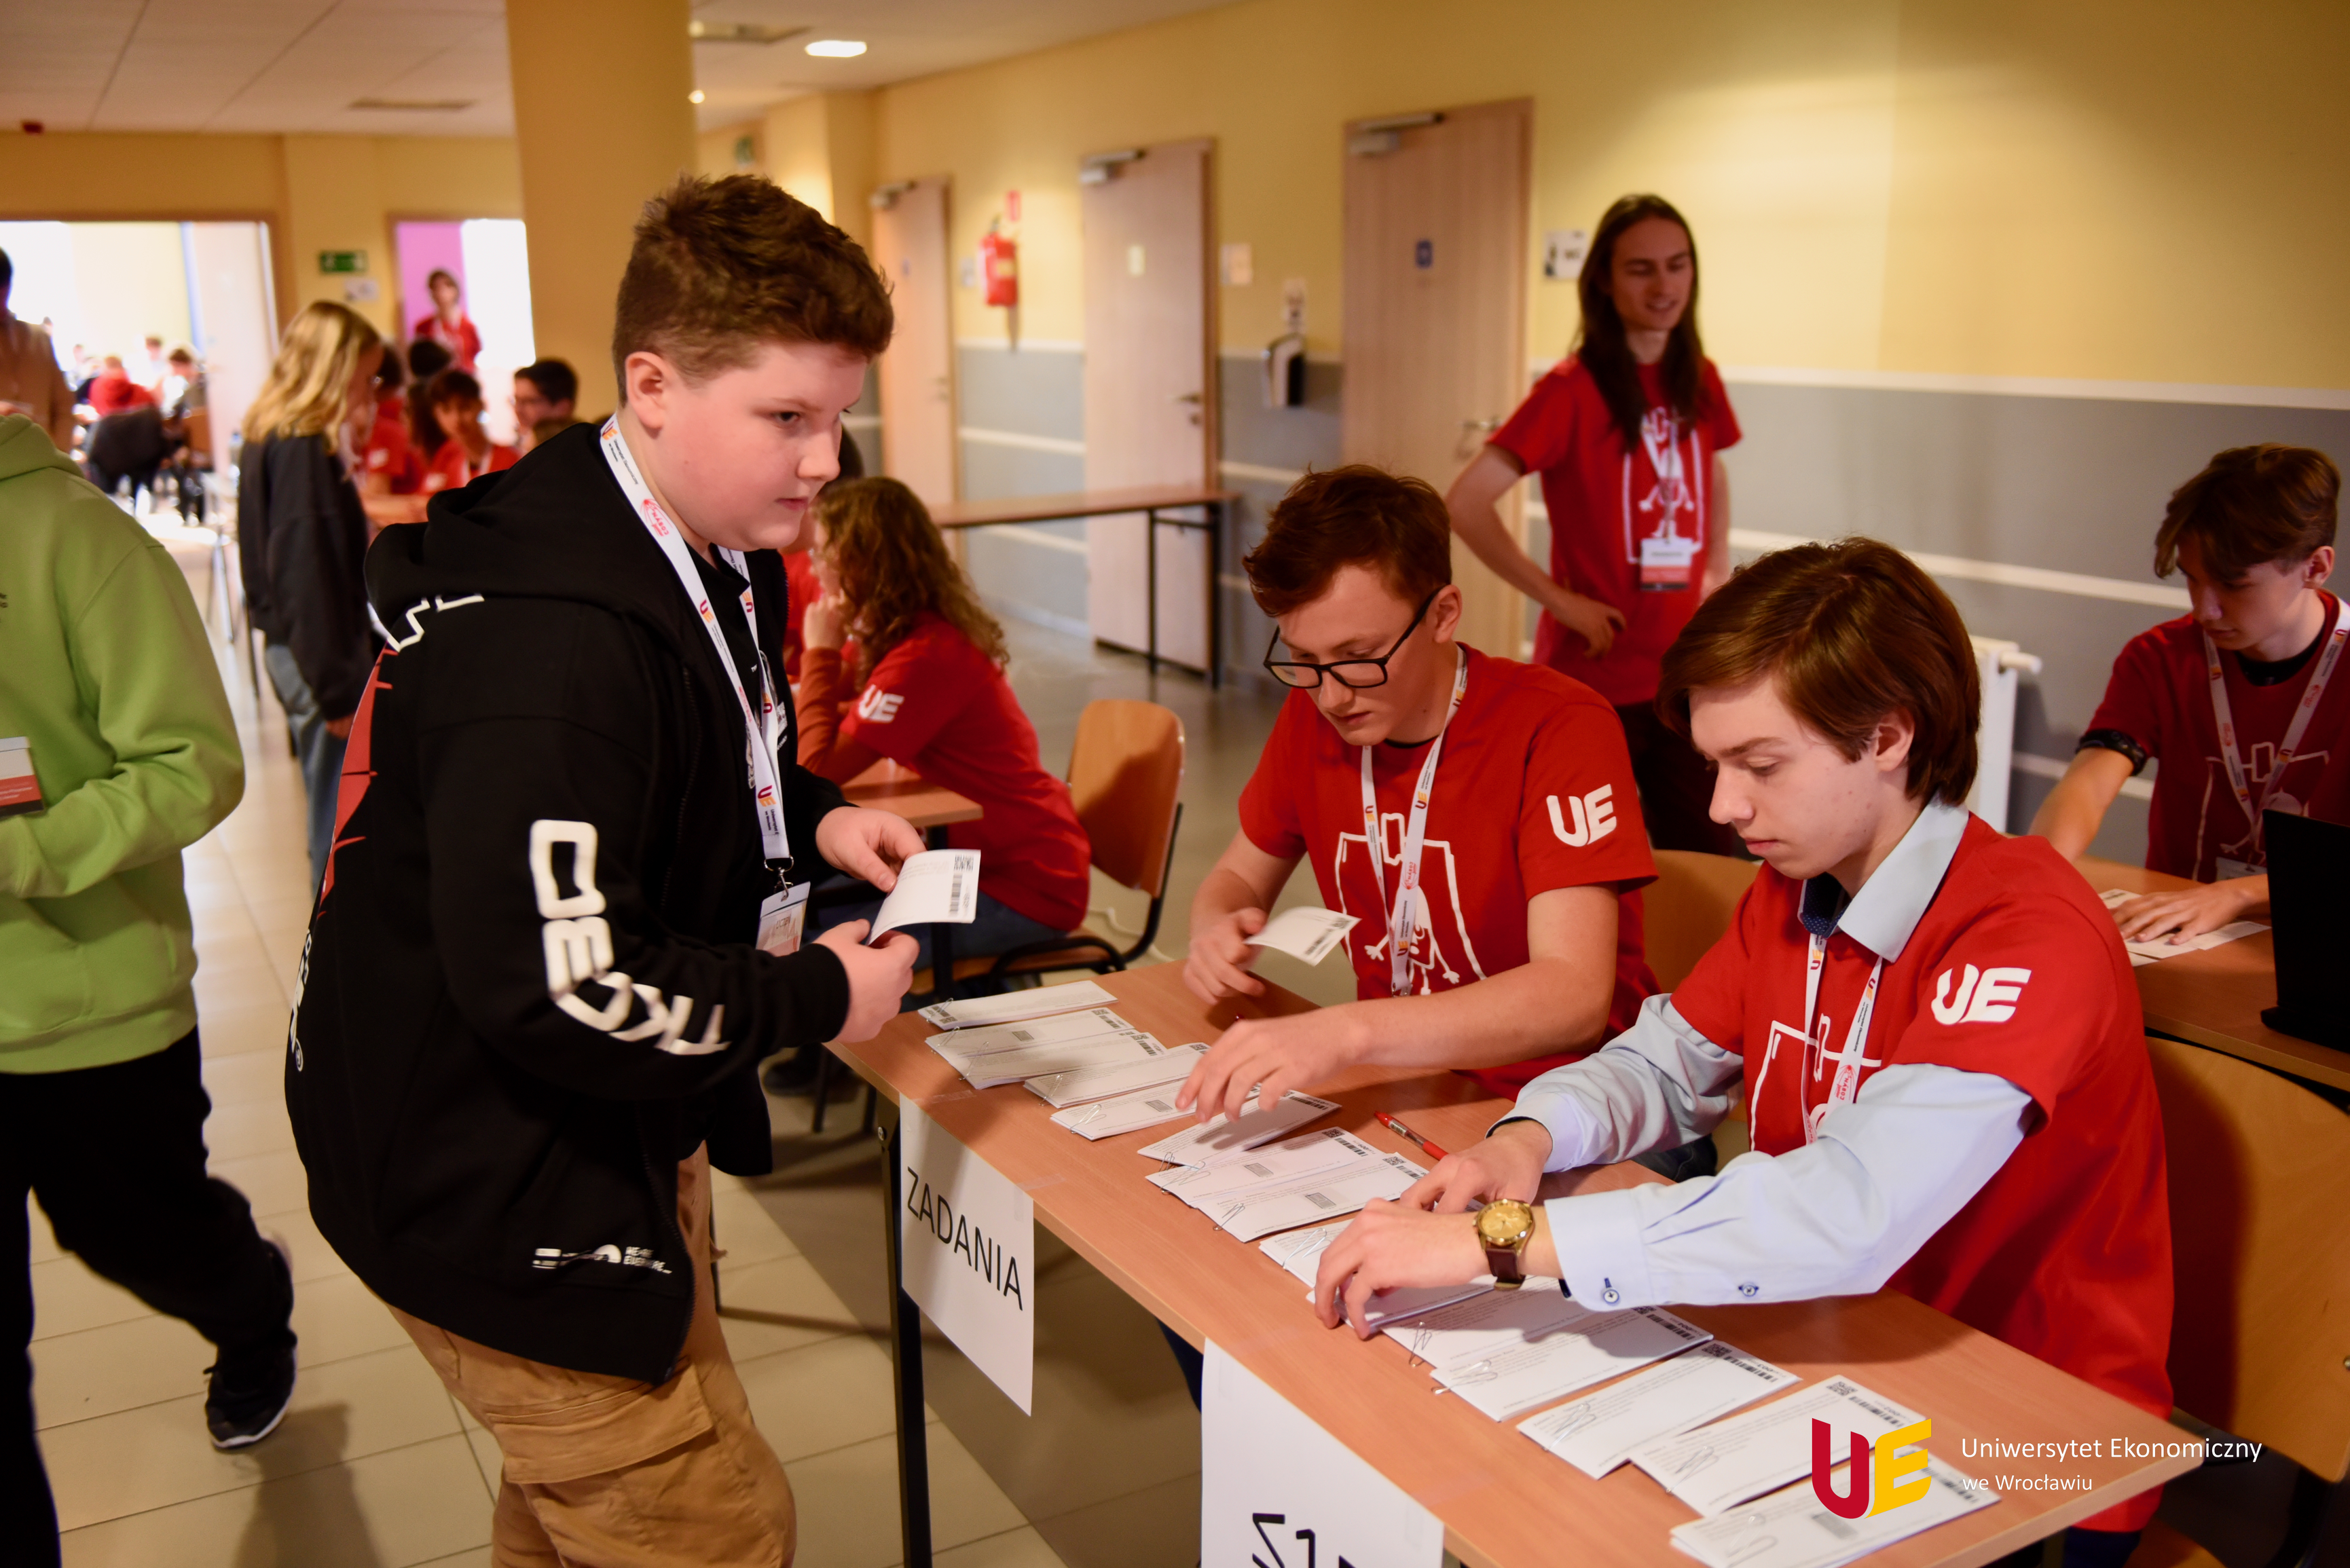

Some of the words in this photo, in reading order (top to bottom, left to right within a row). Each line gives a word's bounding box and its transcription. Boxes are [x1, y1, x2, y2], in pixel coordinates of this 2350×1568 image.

[700, 599, 714, 624] UE
[858, 684, 905, 724] UE
[758, 785, 777, 807] UE
[1415, 791, 1428, 810] UE
[1546, 783, 1617, 847] UE
[1397, 940, 1409, 957] UE
[1810, 949, 1822, 970] UE
[1866, 977, 1876, 1001] UE
[1931, 963, 2032, 1026] UE
[907, 1166, 1023, 1311] ZADANIA
